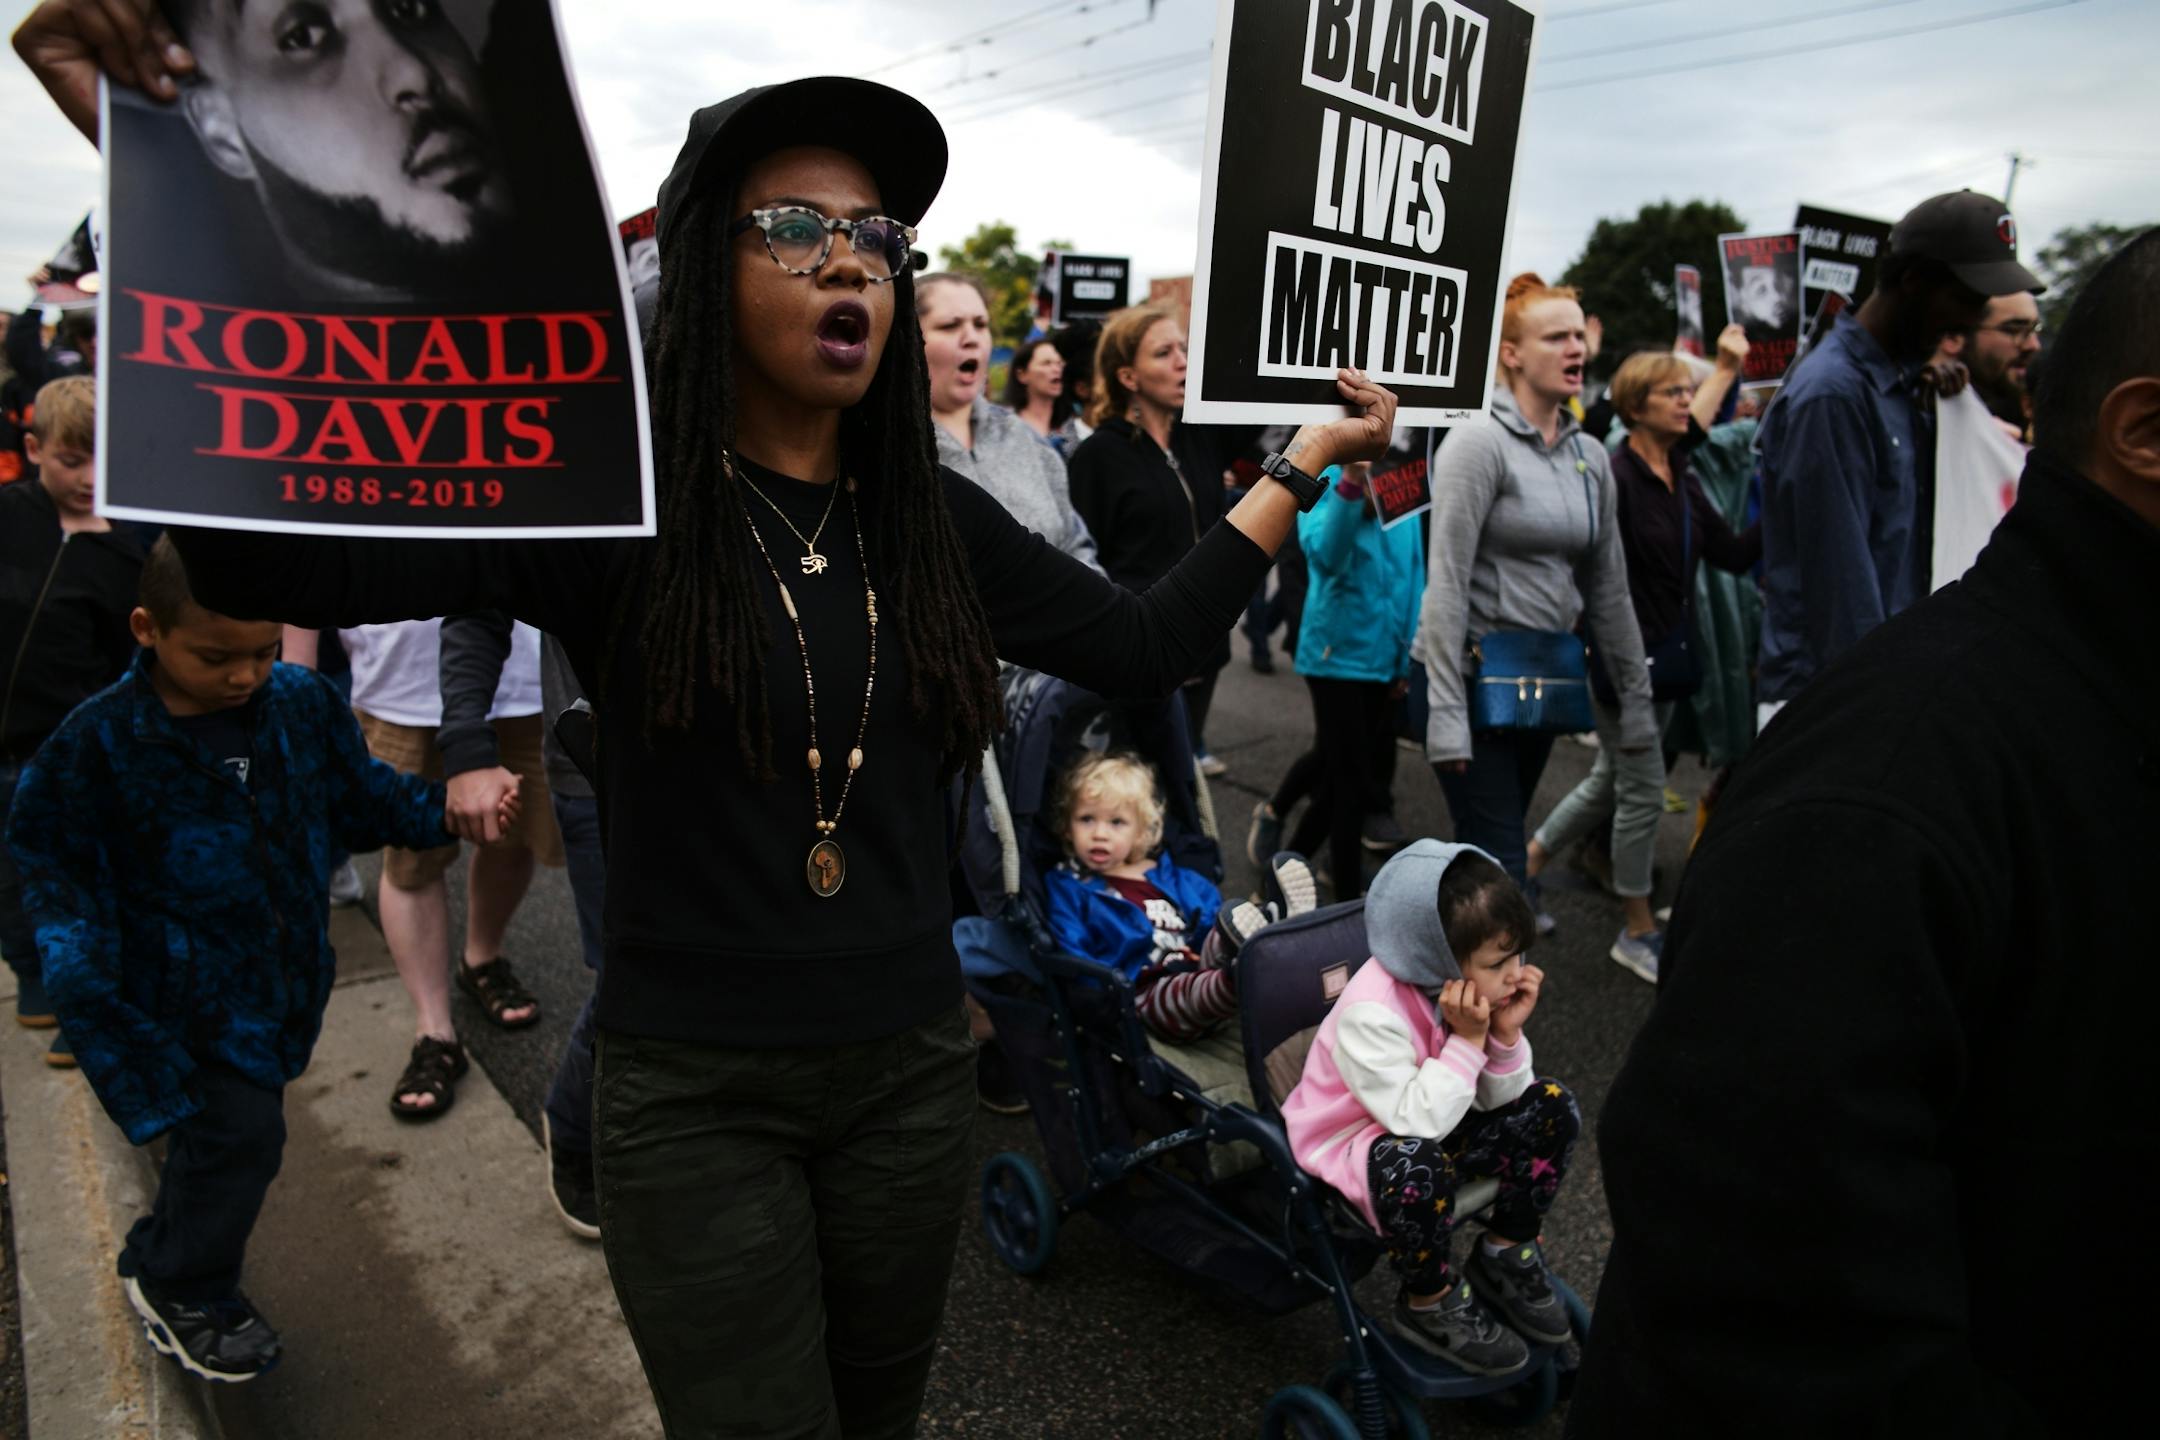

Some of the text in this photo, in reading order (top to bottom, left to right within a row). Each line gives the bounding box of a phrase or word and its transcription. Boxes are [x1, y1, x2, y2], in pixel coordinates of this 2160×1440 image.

[1312, 0, 1480, 132] BLACK
[1312, 108, 1450, 253] LIVES
[120, 287, 618, 385] RONALD
[1268, 245, 1458, 376] MATTER
[195, 383, 564, 467] DAVIS
[280, 475, 504, 507] 1988-2019
